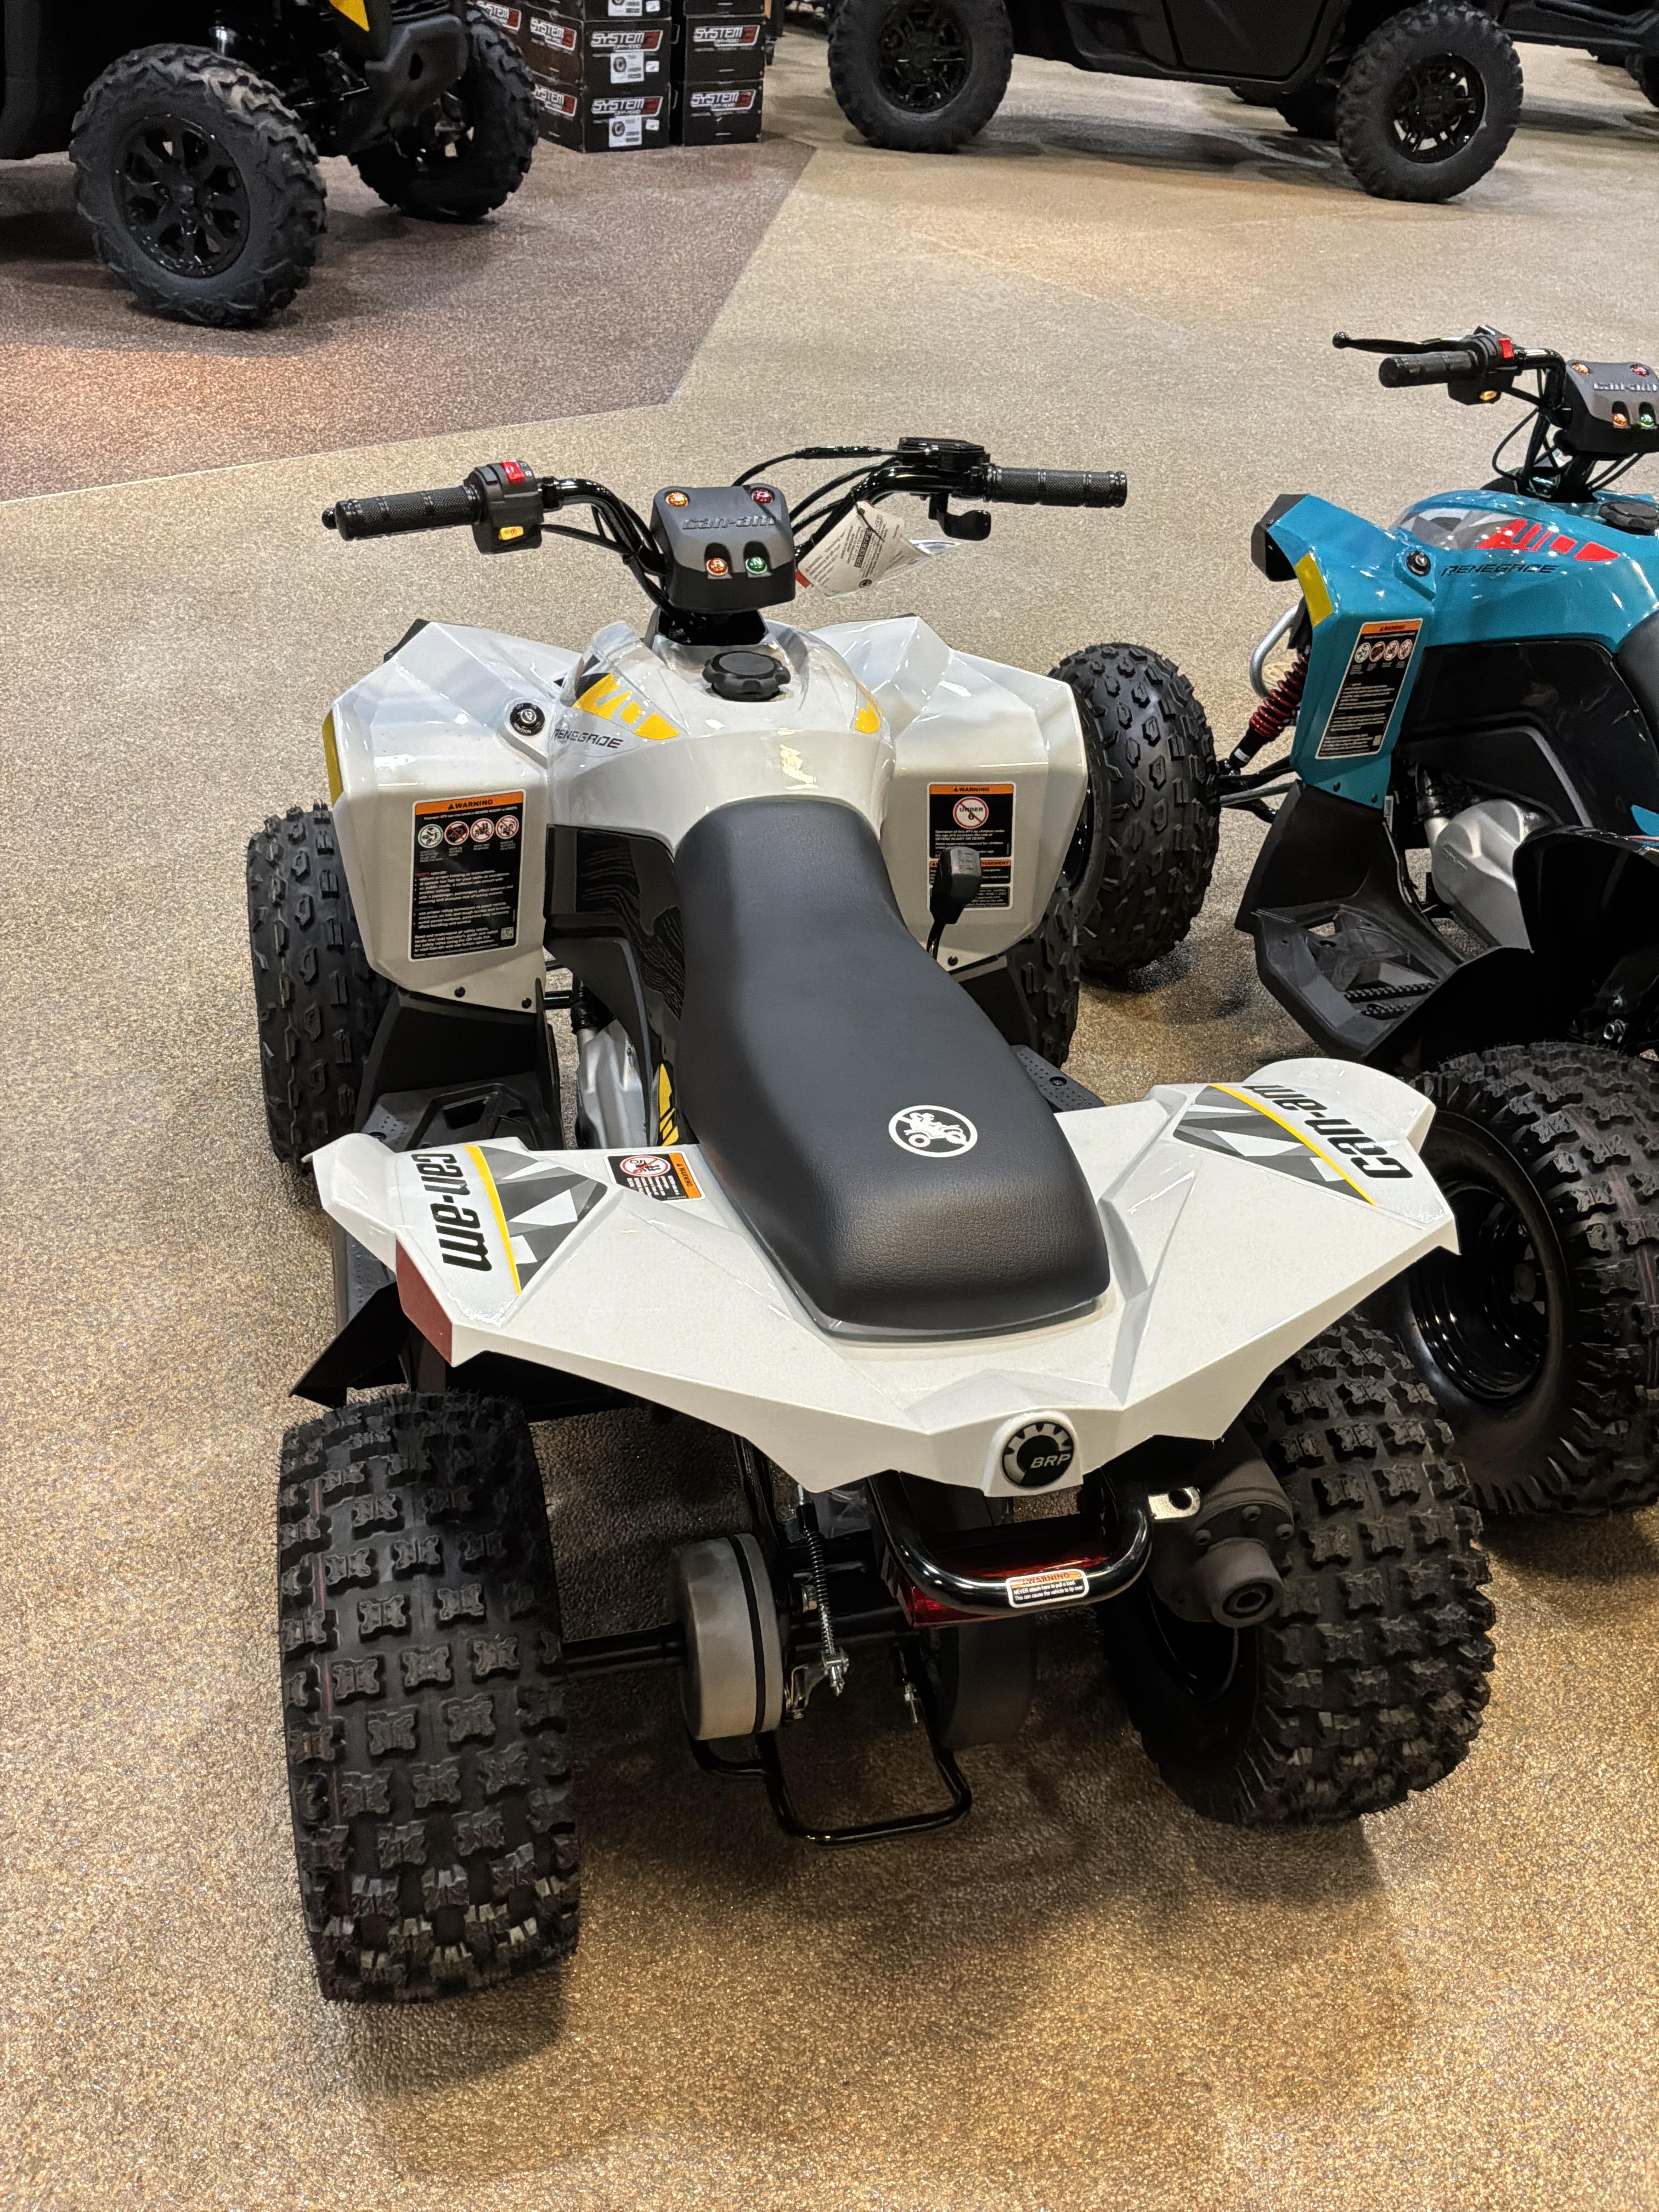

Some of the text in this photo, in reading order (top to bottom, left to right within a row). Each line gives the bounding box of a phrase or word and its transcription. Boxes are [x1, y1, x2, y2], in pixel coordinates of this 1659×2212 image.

[591, 32, 645, 44] SYSTEM
[693, 27, 743, 39] SYSTEM
[592, 99, 645, 110] SYSTEM
[691, 92, 740, 104] SYSTEM
[682, 515, 775, 530] can-am
[1441, 563, 1559, 576] RENEGADE
[553, 729, 624, 749] RENEGADE
[455, 799, 494, 809] WARNING
[1242, 1085, 1414, 1178] can-am
[679, 1167, 693, 1187] WARNING
[411, 1153, 493, 1272] can-am
[1030, 1454, 1070, 1469] BRP
